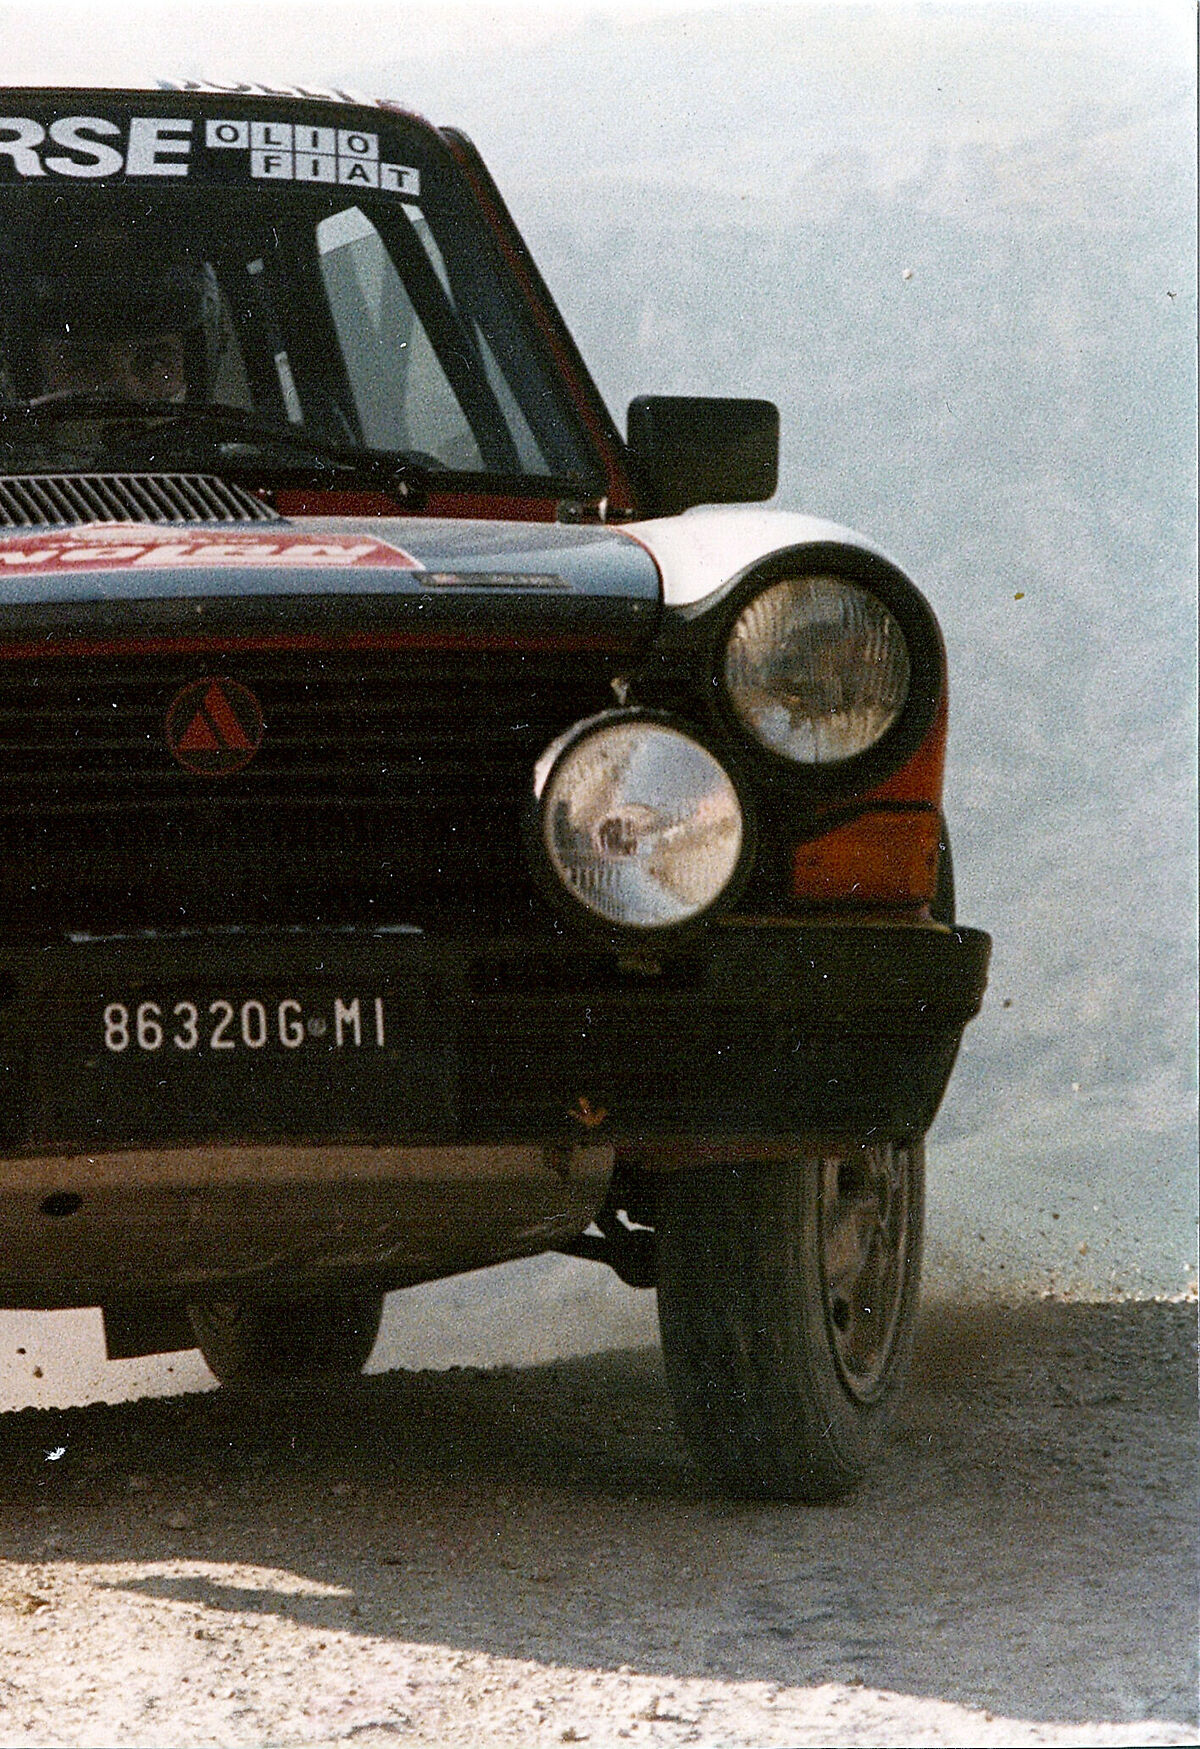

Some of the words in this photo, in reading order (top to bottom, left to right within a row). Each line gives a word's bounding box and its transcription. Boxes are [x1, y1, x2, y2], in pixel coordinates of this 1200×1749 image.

[214, 123, 370, 155] OLIO
[262, 154, 412, 189] FIAT
[102, 999, 305, 1052] 86320G
[333, 996, 386, 1048] MI
